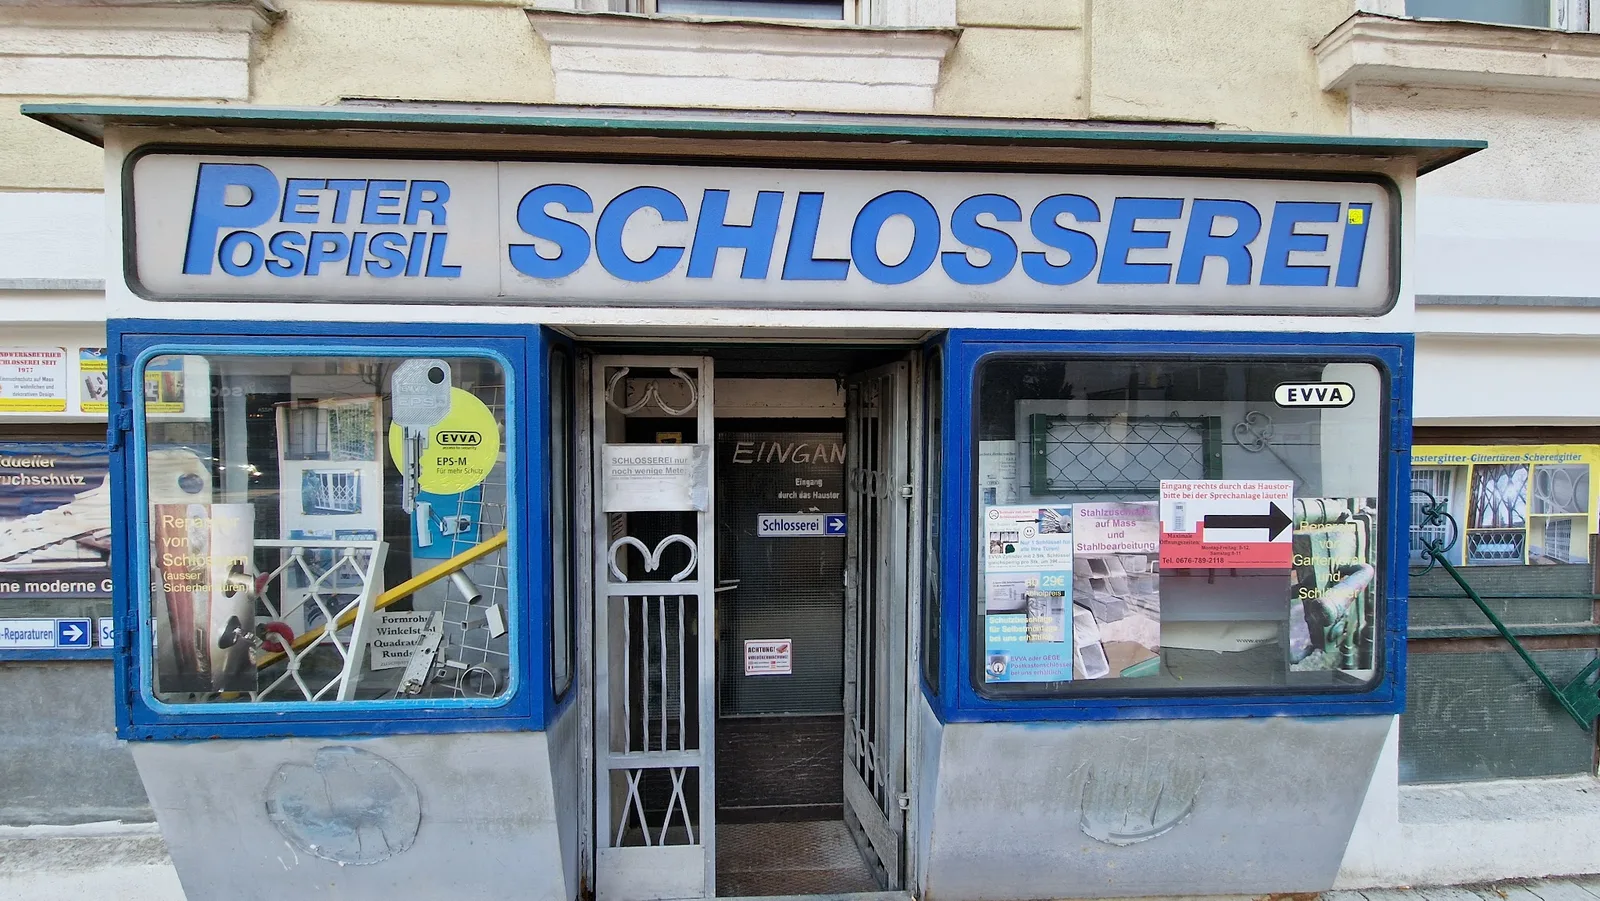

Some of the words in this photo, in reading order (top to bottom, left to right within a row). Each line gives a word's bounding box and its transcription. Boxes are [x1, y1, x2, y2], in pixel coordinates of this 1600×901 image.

[190, 163, 450, 228] PETER
[508, 183, 1373, 288] SCHLOSSEREI
[183, 218, 462, 279] POSPISIL
[1287, 387, 1344, 402] EVVA
[442, 434, 477, 443] EVVA
[436, 457, 467, 466] EPS-M
[611, 457, 673, 465] SCHLOSSEREI
[437, 466, 447, 475] Für
[448, 466, 463, 475] mehr
[634, 467, 664, 476] wenige
[795, 478, 823, 488] Eingang
[1161, 483, 1192, 492] Eingang
[1193, 482, 1218, 490] rechts
[1218, 482, 1245, 490] durch
[1246, 482, 1256, 490] das
[1257, 482, 1291, 490] Haustor-
[778, 490, 798, 499] durch
[798, 490, 811, 499] das
[812, 490, 841, 499] Haustor
[1209, 492, 1262, 502] Sprechanlage
[762, 519, 820, 532] Schlosserei
[1095, 520, 1110, 528] auf
[1112, 519, 1137, 528] Mass
[1107, 531, 1125, 539] und
[162, 537, 189, 548] von
[1076, 541, 1156, 551] Stahlbearbeitung
[1175, 557, 1225, 565] 0676-789-2118
[163, 572, 202, 582] (ausser
[1042, 575, 1065, 587] 29€
[25, 580, 96, 593] moderne
[373, 639, 418, 649] Quadrat
